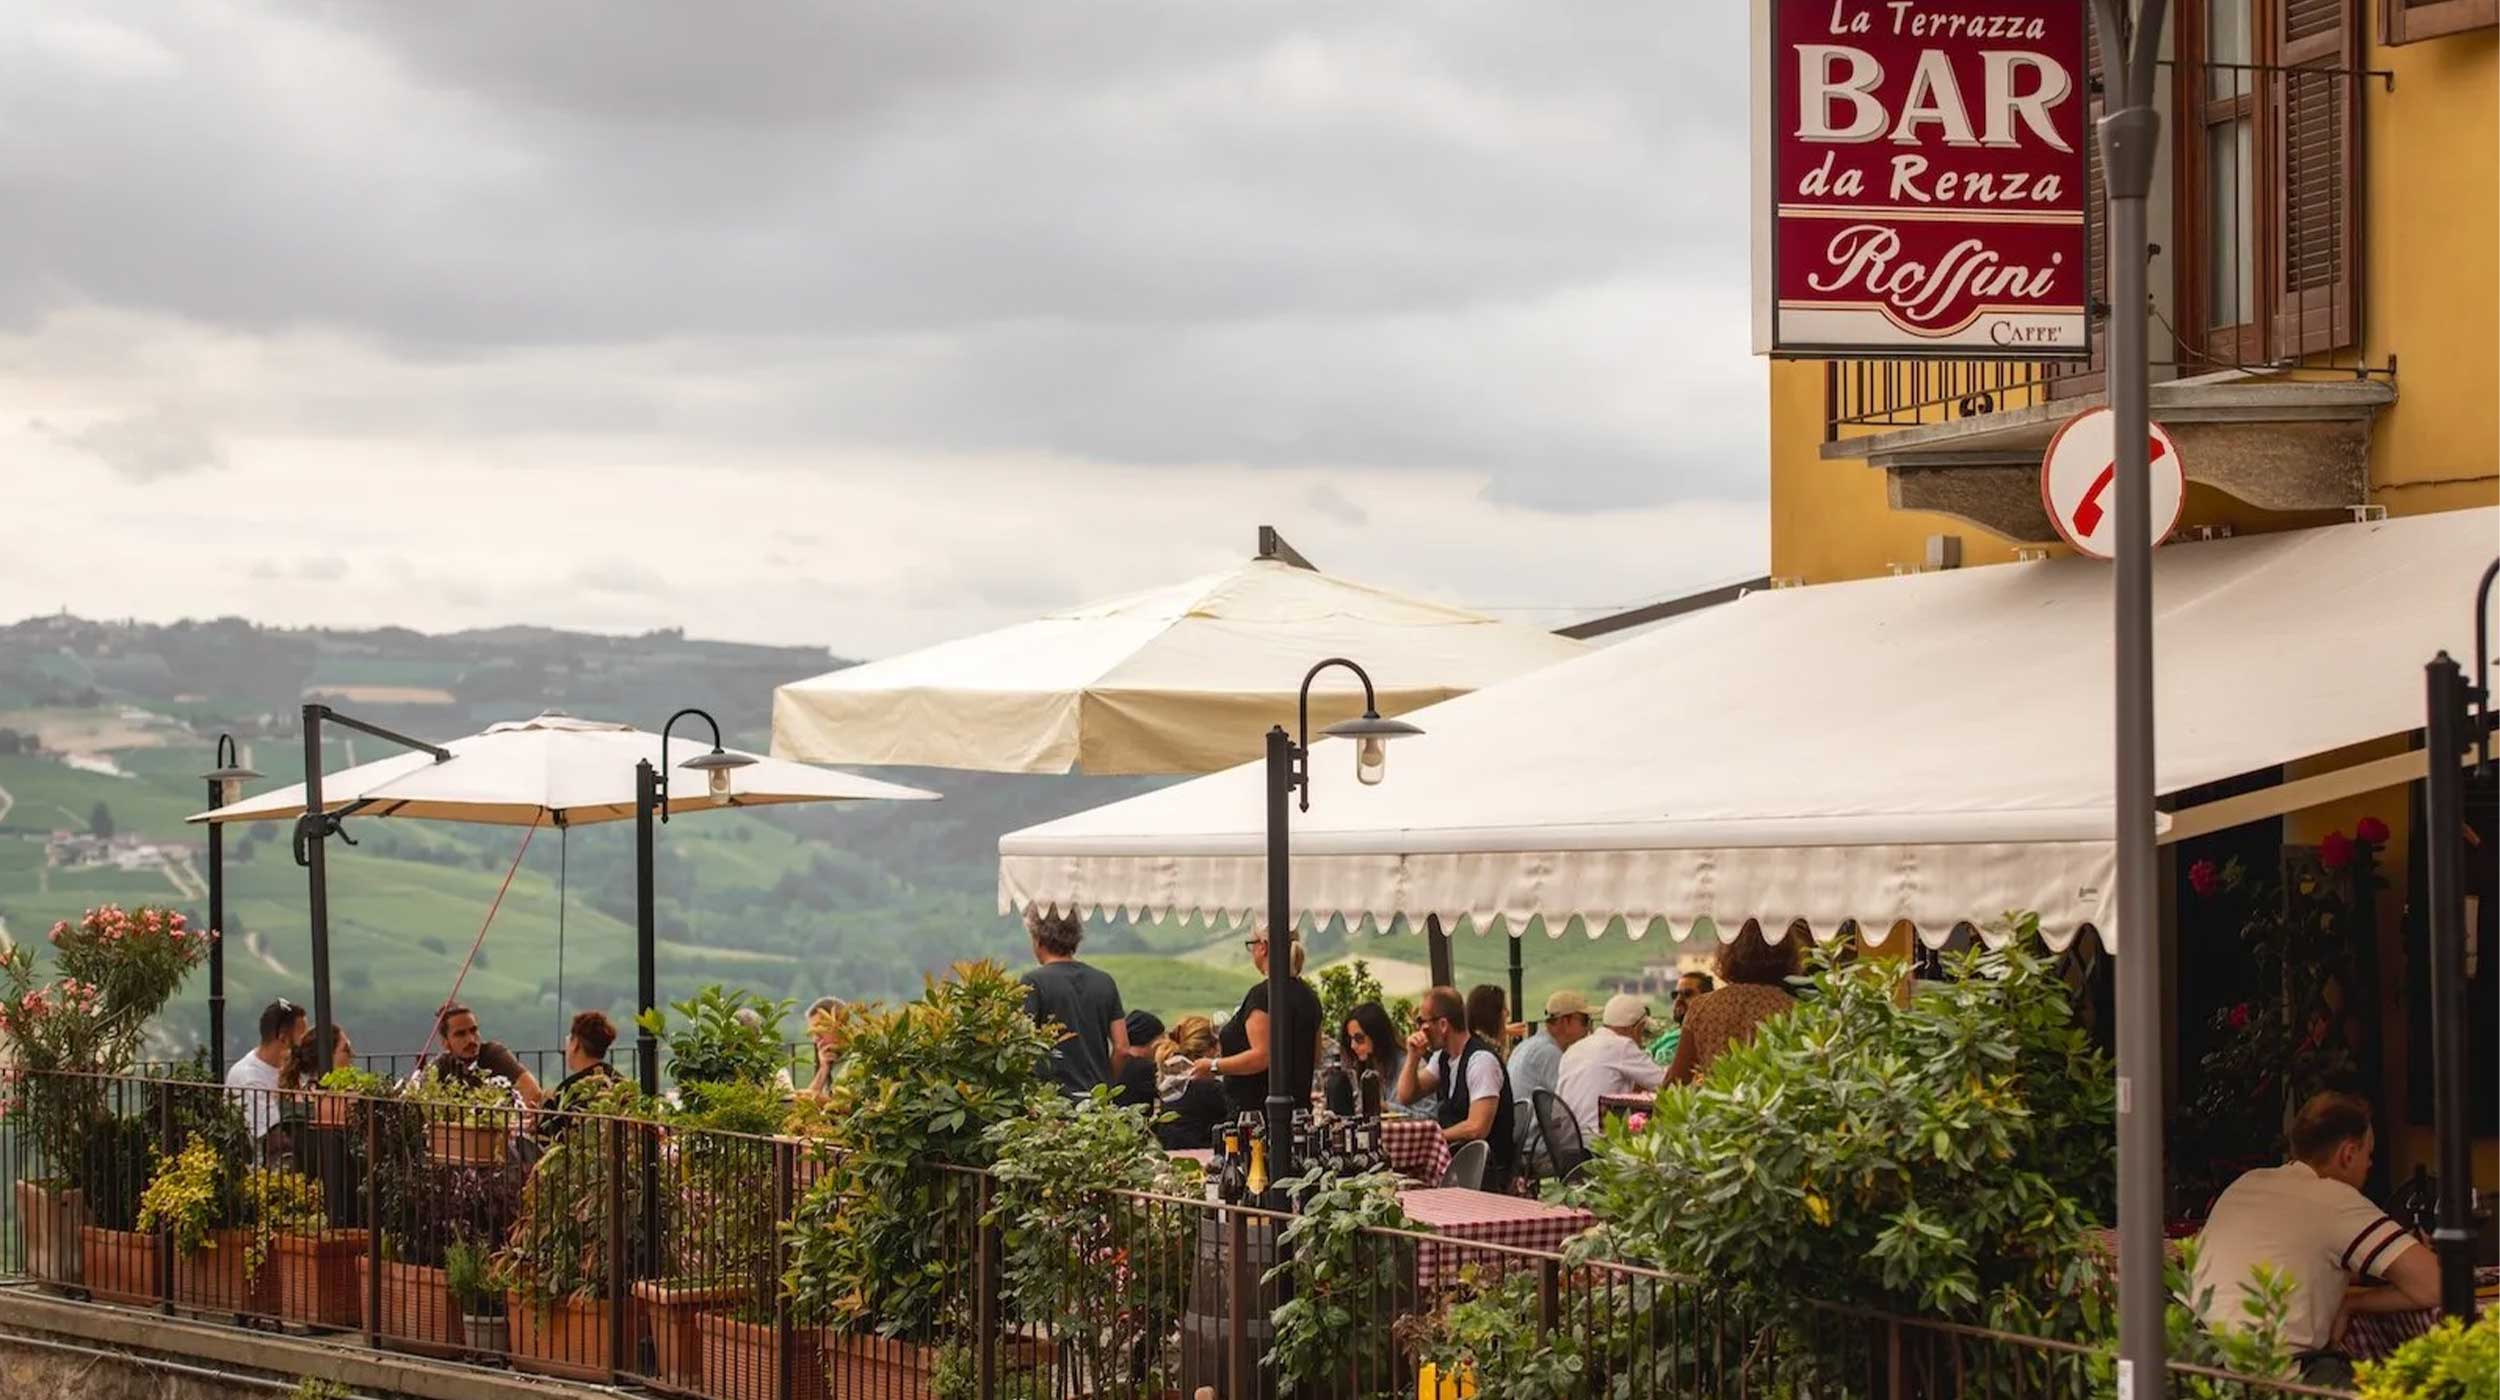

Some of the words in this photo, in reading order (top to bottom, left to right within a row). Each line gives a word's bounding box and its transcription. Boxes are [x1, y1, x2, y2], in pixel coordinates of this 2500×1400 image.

[1829, 0, 1871, 35] La
[1887, 1, 2046, 40] Terrazza
[1793, 44, 2075, 154] BAR
[1799, 150, 1864, 198] da
[1890, 154, 2062, 203] Renza
[1808, 224, 2062, 321] Rossini
